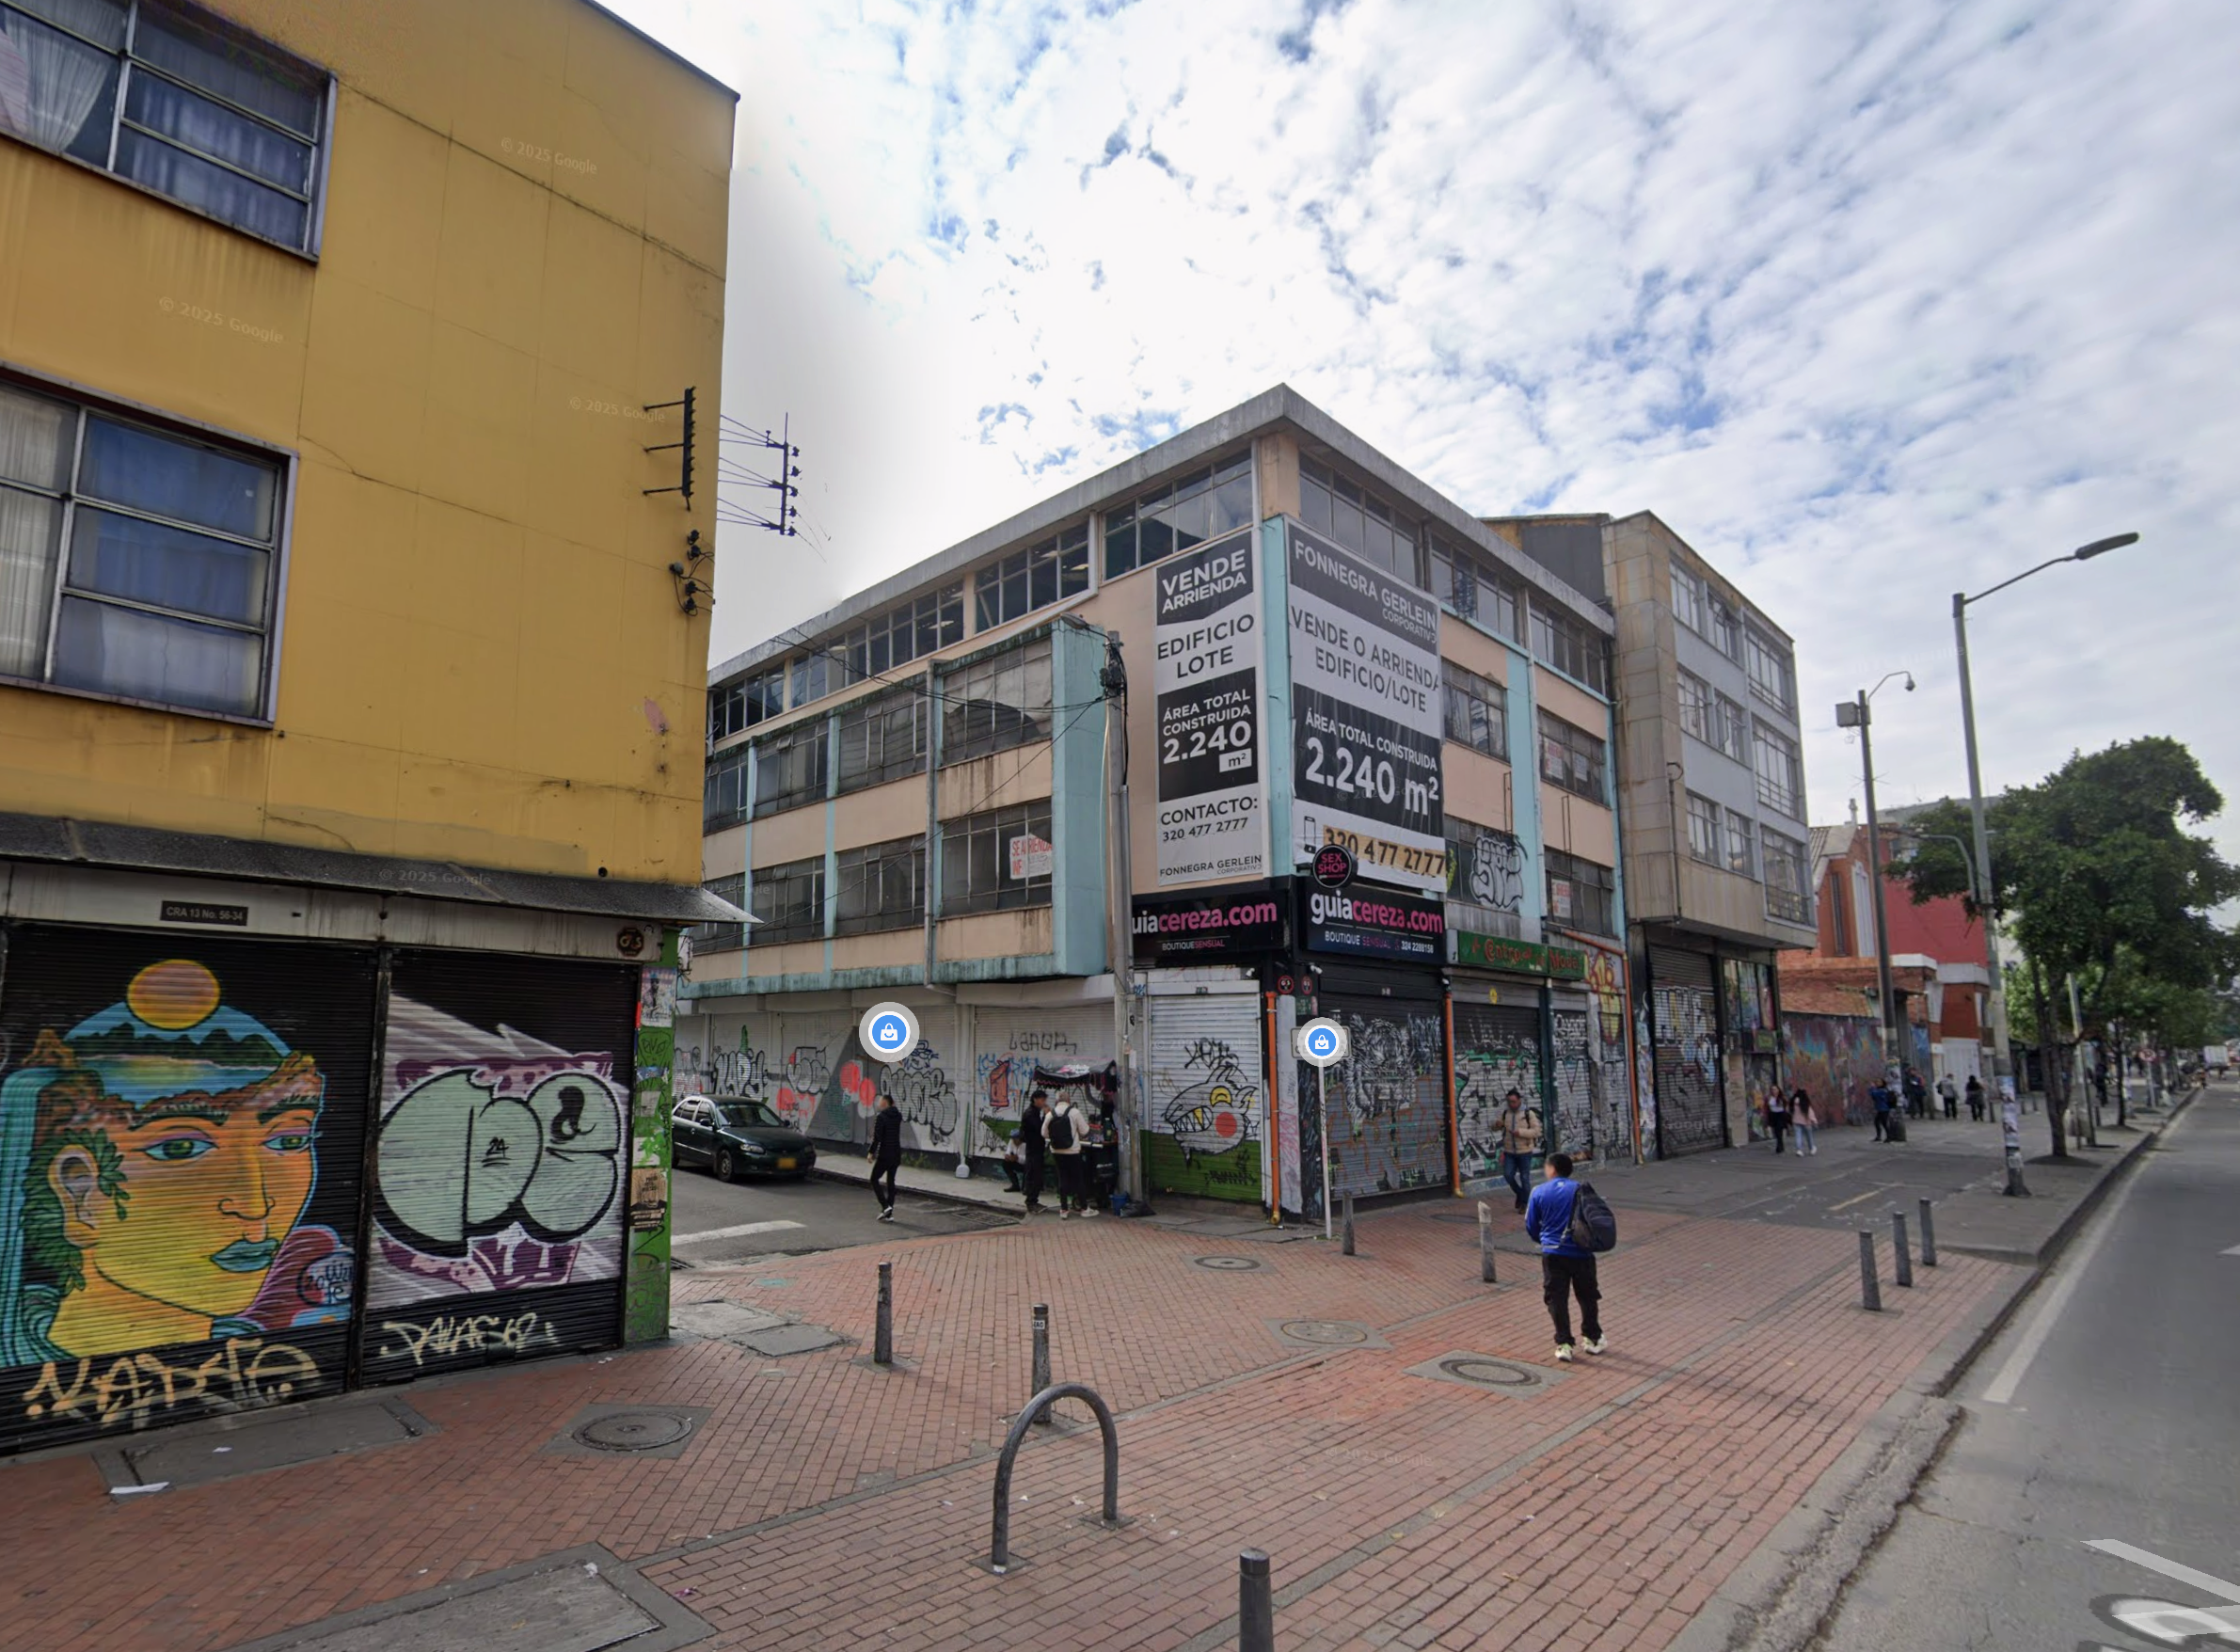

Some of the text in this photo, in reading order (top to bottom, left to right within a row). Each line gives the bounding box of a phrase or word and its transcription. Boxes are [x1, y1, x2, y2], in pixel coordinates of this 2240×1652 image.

[1162, 548, 1246, 596] VENDE
[1295, 539, 1437, 630] FONNEGRA GERLEIN
[1162, 571, 1247, 614] ARRIENDA
[1157, 613, 1255, 659] EDIFICIO
[1291, 605, 1349, 651] VENDE
[1353, 635, 1365, 658] O
[1381, 608, 1438, 644] CORPORATIVO
[1177, 645, 1233, 678] LOTE
[1315, 645, 1426, 713] EDIFICIO/LOTE
[1163, 689, 1251, 723] ÁREA TOTAL
[1163, 704, 1251, 736] CONSTRUIDA
[1163, 720, 1252, 765] 2.240
[1305, 707, 1438, 771] ÁREA TOTAL CONSTRUIDA
[1305, 737, 1396, 804] 2.240
[1160, 796, 1258, 826] CONTACTO:
[1163, 817, 1248, 842] 320 477 2777
[1159, 854, 1262, 877] FONNEGRA GERLEIN
[1318, 863, 1347, 874] SHOP
[1321, 852, 1342, 864] SEX
[1364, 839, 1399, 866] 477
[1404, 848, 1446, 876] 2777
[166, 906, 188, 917] CRA
[189, 908, 200, 918] 13
[1132, 902, 1278, 934] uiacereza.com
[1311, 889, 1443, 934] guiacereza.com
[1325, 930, 1360, 945] BOUTIQUE
